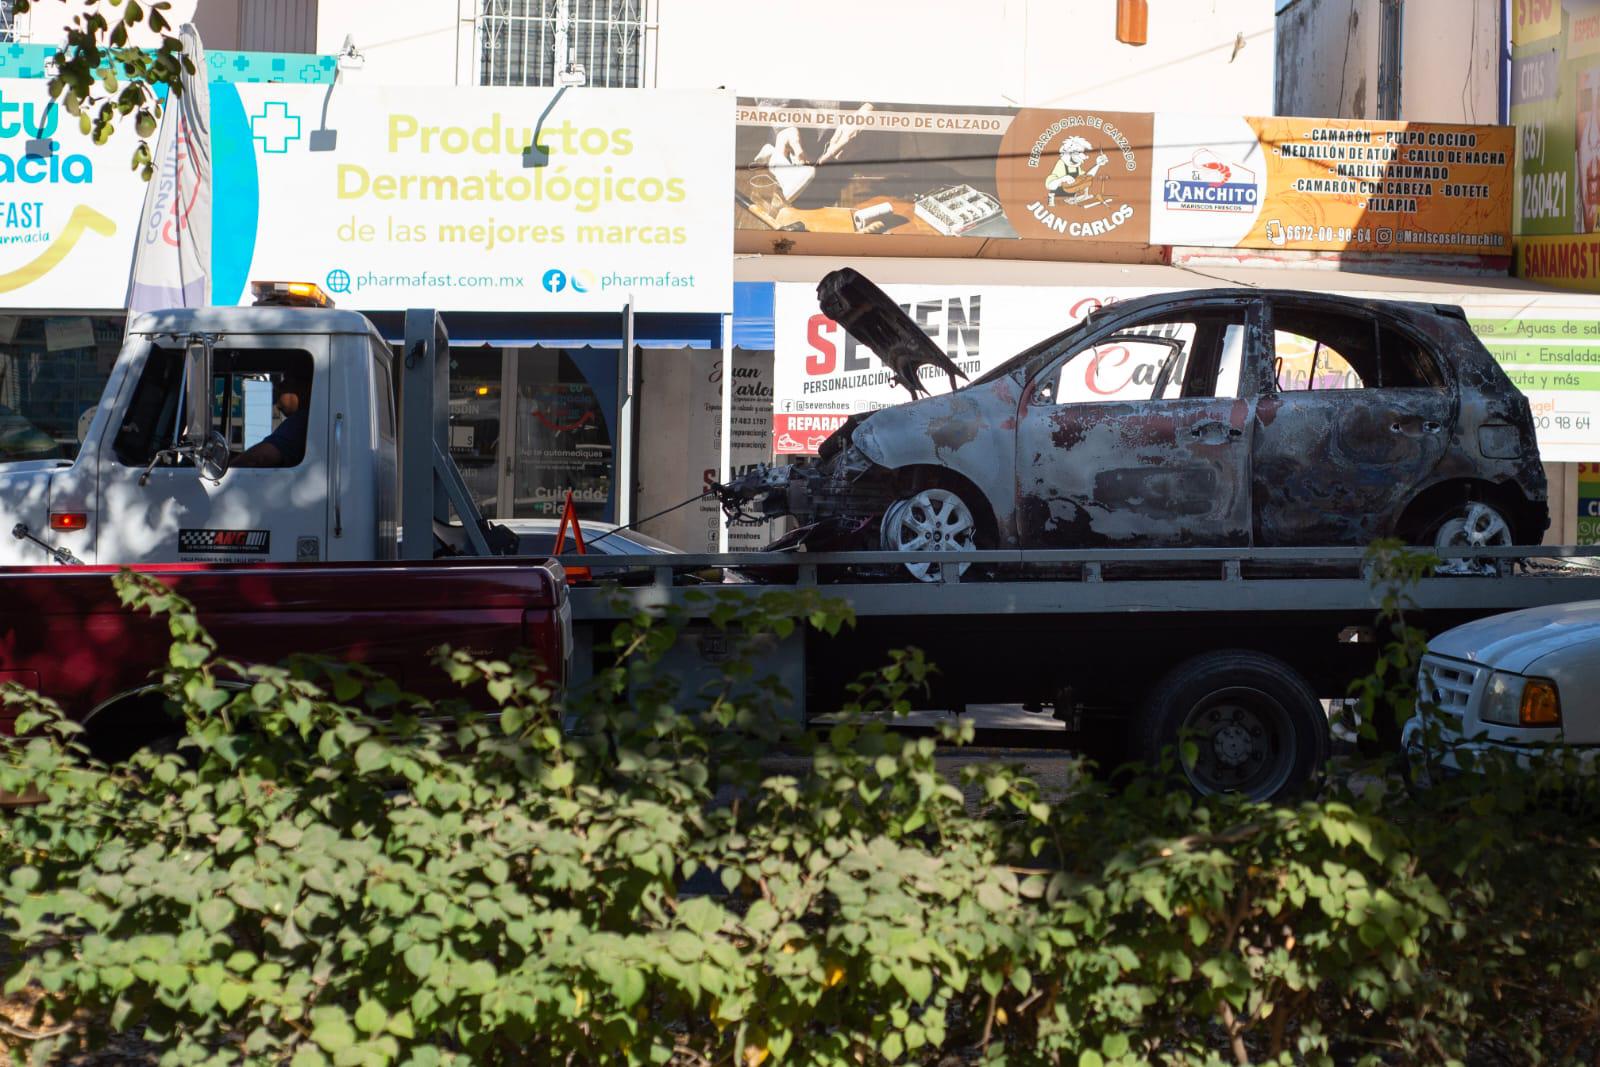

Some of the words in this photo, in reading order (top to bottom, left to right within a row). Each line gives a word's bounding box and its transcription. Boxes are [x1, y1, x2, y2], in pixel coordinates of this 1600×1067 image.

[1521, 61, 1545, 99] CITAS
[816, 113, 834, 124] DE
[838, 114, 875, 126] TODO
[880, 116, 910, 127] TIPO
[914, 117, 932, 128] DE
[936, 118, 1000, 130] CALZADO
[387, 112, 634, 155] Productos
[1086, 115, 1103, 129] DE
[1103, 122, 1137, 172] CALZADO
[1386, 131, 1425, 145] PULPO
[1428, 132, 1476, 147] COCIDO
[1281, 143, 1345, 159] MEDALLÓN
[1349, 147, 1363, 160] DE
[1448, 151, 1462, 163] DE
[1465, 152, 1505, 165] HACHA
[1388, 166, 1448, 180] AHUMADO
[336, 163, 687, 213] Dermatológicos
[1166, 181, 1257, 203] RANCHITO
[1360, 181, 1383, 194] CON
[1387, 182, 1432, 195] CABEZA
[1368, 199, 1417, 212] TILAPIA
[1026, 200, 1067, 233] JUAN
[1069, 203, 1134, 237] CARLOS
[336, 215, 375, 242] de
[387, 216, 427, 242] las
[438, 217, 566, 250] mejores
[576, 225, 687, 244] marcas
[1525, 241, 1588, 279] SANAMOS
[356, 270, 525, 291] pharmafast.com.mx
[601, 271, 695, 290] pharmafast
[1517, 319, 1557, 338] Aguas
[1562, 320, 1578, 334] de
[803, 370, 891, 394] PERSONALIZACIÓN
[1541, 376, 1548, 389] y
[1553, 373, 1580, 386] más
[1555, 416, 1571, 430] 98
[1576, 416, 1591, 430] 64
